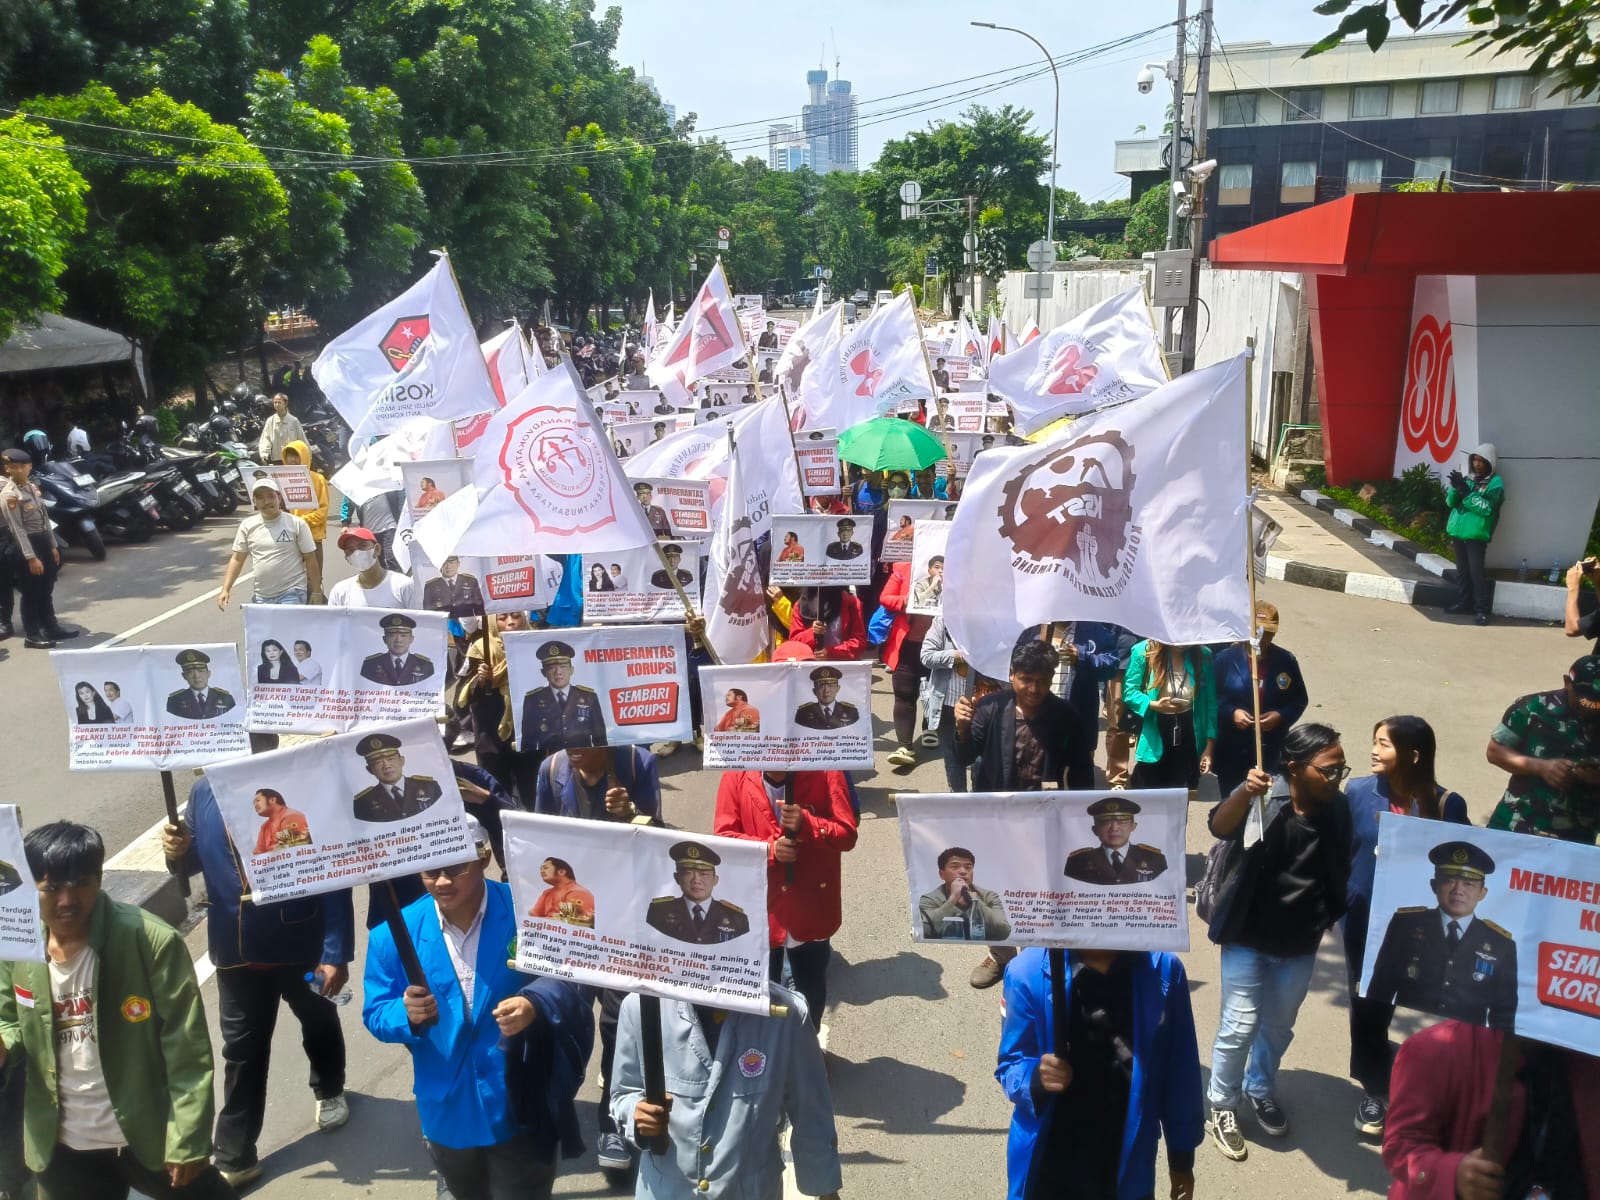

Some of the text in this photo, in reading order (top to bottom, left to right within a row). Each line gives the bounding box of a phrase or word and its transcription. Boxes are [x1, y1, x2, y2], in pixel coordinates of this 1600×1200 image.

[491, 570, 528, 584] SEMBARI
[493, 582, 530, 595] KORUPSI
[584, 646, 675, 663] MEMBERANTAS
[627, 662, 676, 677] KORUPSI
[617, 688, 669, 703] SEMBARI
[619, 703, 670, 719] KORUPSI
[251, 852, 291, 865] Sugianto
[296, 848, 317, 856] alias
[321, 844, 343, 852] Asun
[347, 837, 370, 849] pelaku
[374, 832, 396, 841] utama
[426, 818, 449, 829] mining
[276, 862, 293, 871] yang
[375, 841, 384, 849] 10
[387, 836, 418, 847] Triliun.
[420, 826, 446, 839] Sampai
[448, 823, 462, 832] Hari
[273, 870, 290, 880] tidak
[298, 863, 325, 874] menjadi
[331, 850, 389, 868] TERSANGKA.
[397, 844, 421, 854] Diduga
[296, 873, 325, 885] Febrie
[327, 861, 378, 878] Adriansyah
[380, 858, 406, 867] dengan
[407, 852, 430, 862] diduga
[432, 842, 467, 856] mendapat
[1040, 891, 1076, 900] Hidayat,
[2, 906, 32, 915] Terduga
[523, 920, 567, 934] Sugianto
[572, 929, 596, 940] alias
[601, 934, 626, 945] Asun
[630, 941, 656, 951] pelaku
[661, 946, 685, 956] utama
[690, 950, 716, 961] illegal
[721, 954, 749, 966] mining
[524, 929, 760, 978] Kaltim yang merugikan negara Rp. 10 Triliun. Sampai Hari
[543, 943, 560, 952] tidak
[570, 950, 599, 960] menjadi
[608, 955, 673, 973] TERSANGKA.
[682, 968, 710, 981] Diduga
[720, 975, 760, 989] dilindungi
[555, 969, 575, 978] suap.
[564, 957, 597, 970] Febrie
[598, 964, 656, 980] Adriansyah
[659, 974, 688, 986] dengan
[690, 980, 717, 992] diduga
[720, 988, 760, 998] mendapat
